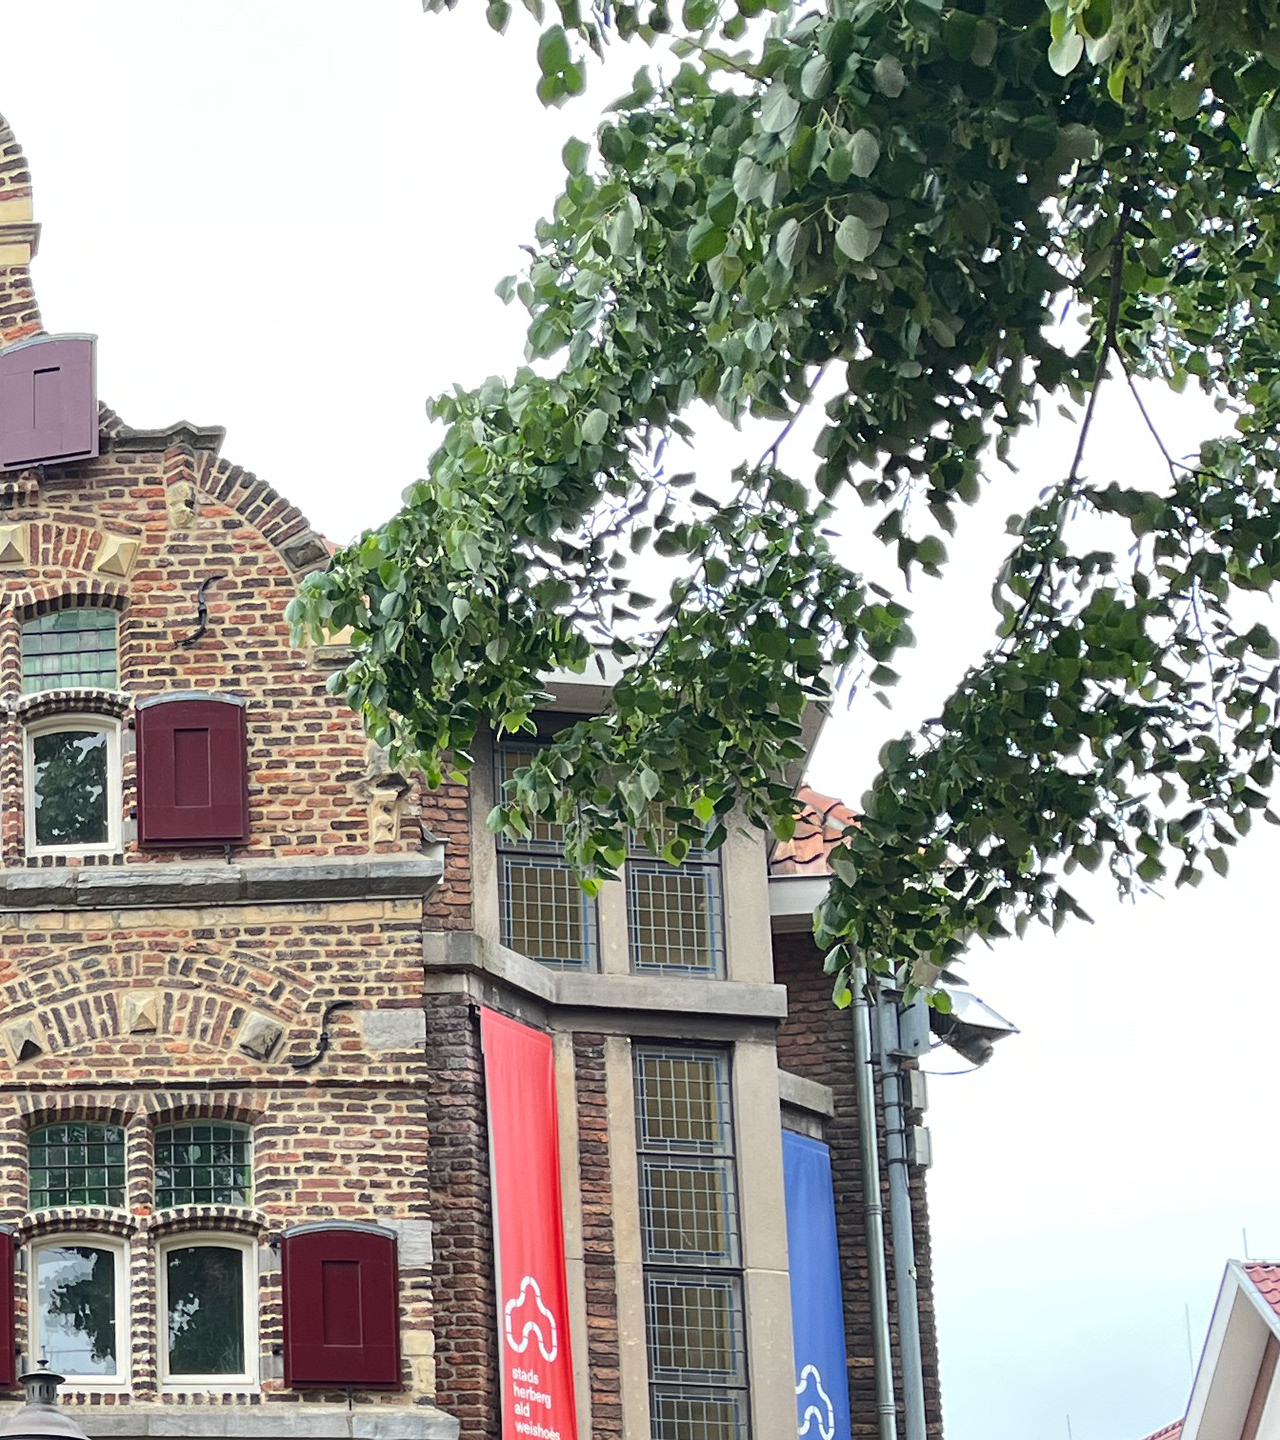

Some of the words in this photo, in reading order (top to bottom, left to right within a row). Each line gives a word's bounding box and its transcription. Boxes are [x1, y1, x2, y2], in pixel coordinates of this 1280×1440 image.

[512, 1367, 539, 1385] stads
[513, 1382, 552, 1409] herberg
[514, 1401, 530, 1417] ald
